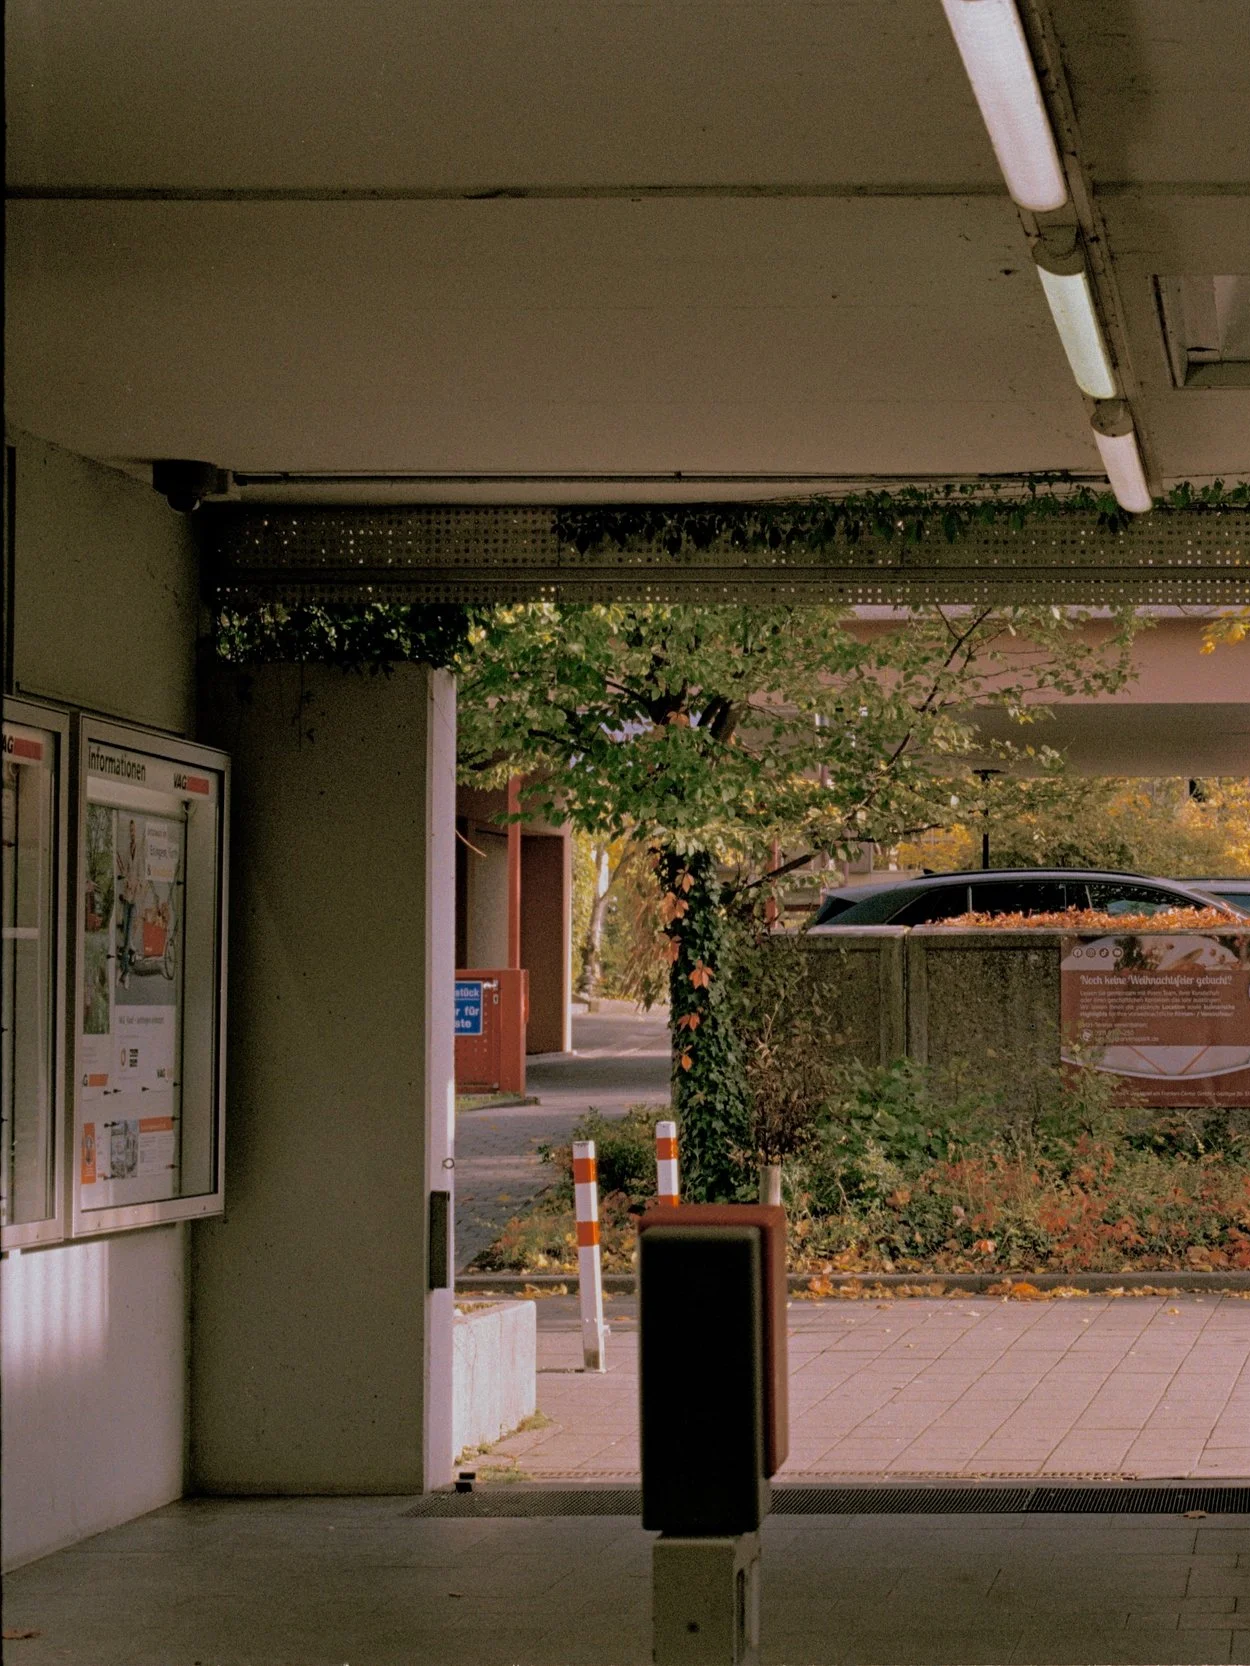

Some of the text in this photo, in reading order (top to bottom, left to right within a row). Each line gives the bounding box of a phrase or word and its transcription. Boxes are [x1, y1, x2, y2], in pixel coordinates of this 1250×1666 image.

[2, 735, 14, 754] AG
[88, 746, 187, 790] Informationen VAG
[1080, 975, 1232, 987] Noch keine Weihnachtsfeier gebucht?
[464, 1006, 480, 1016] für
